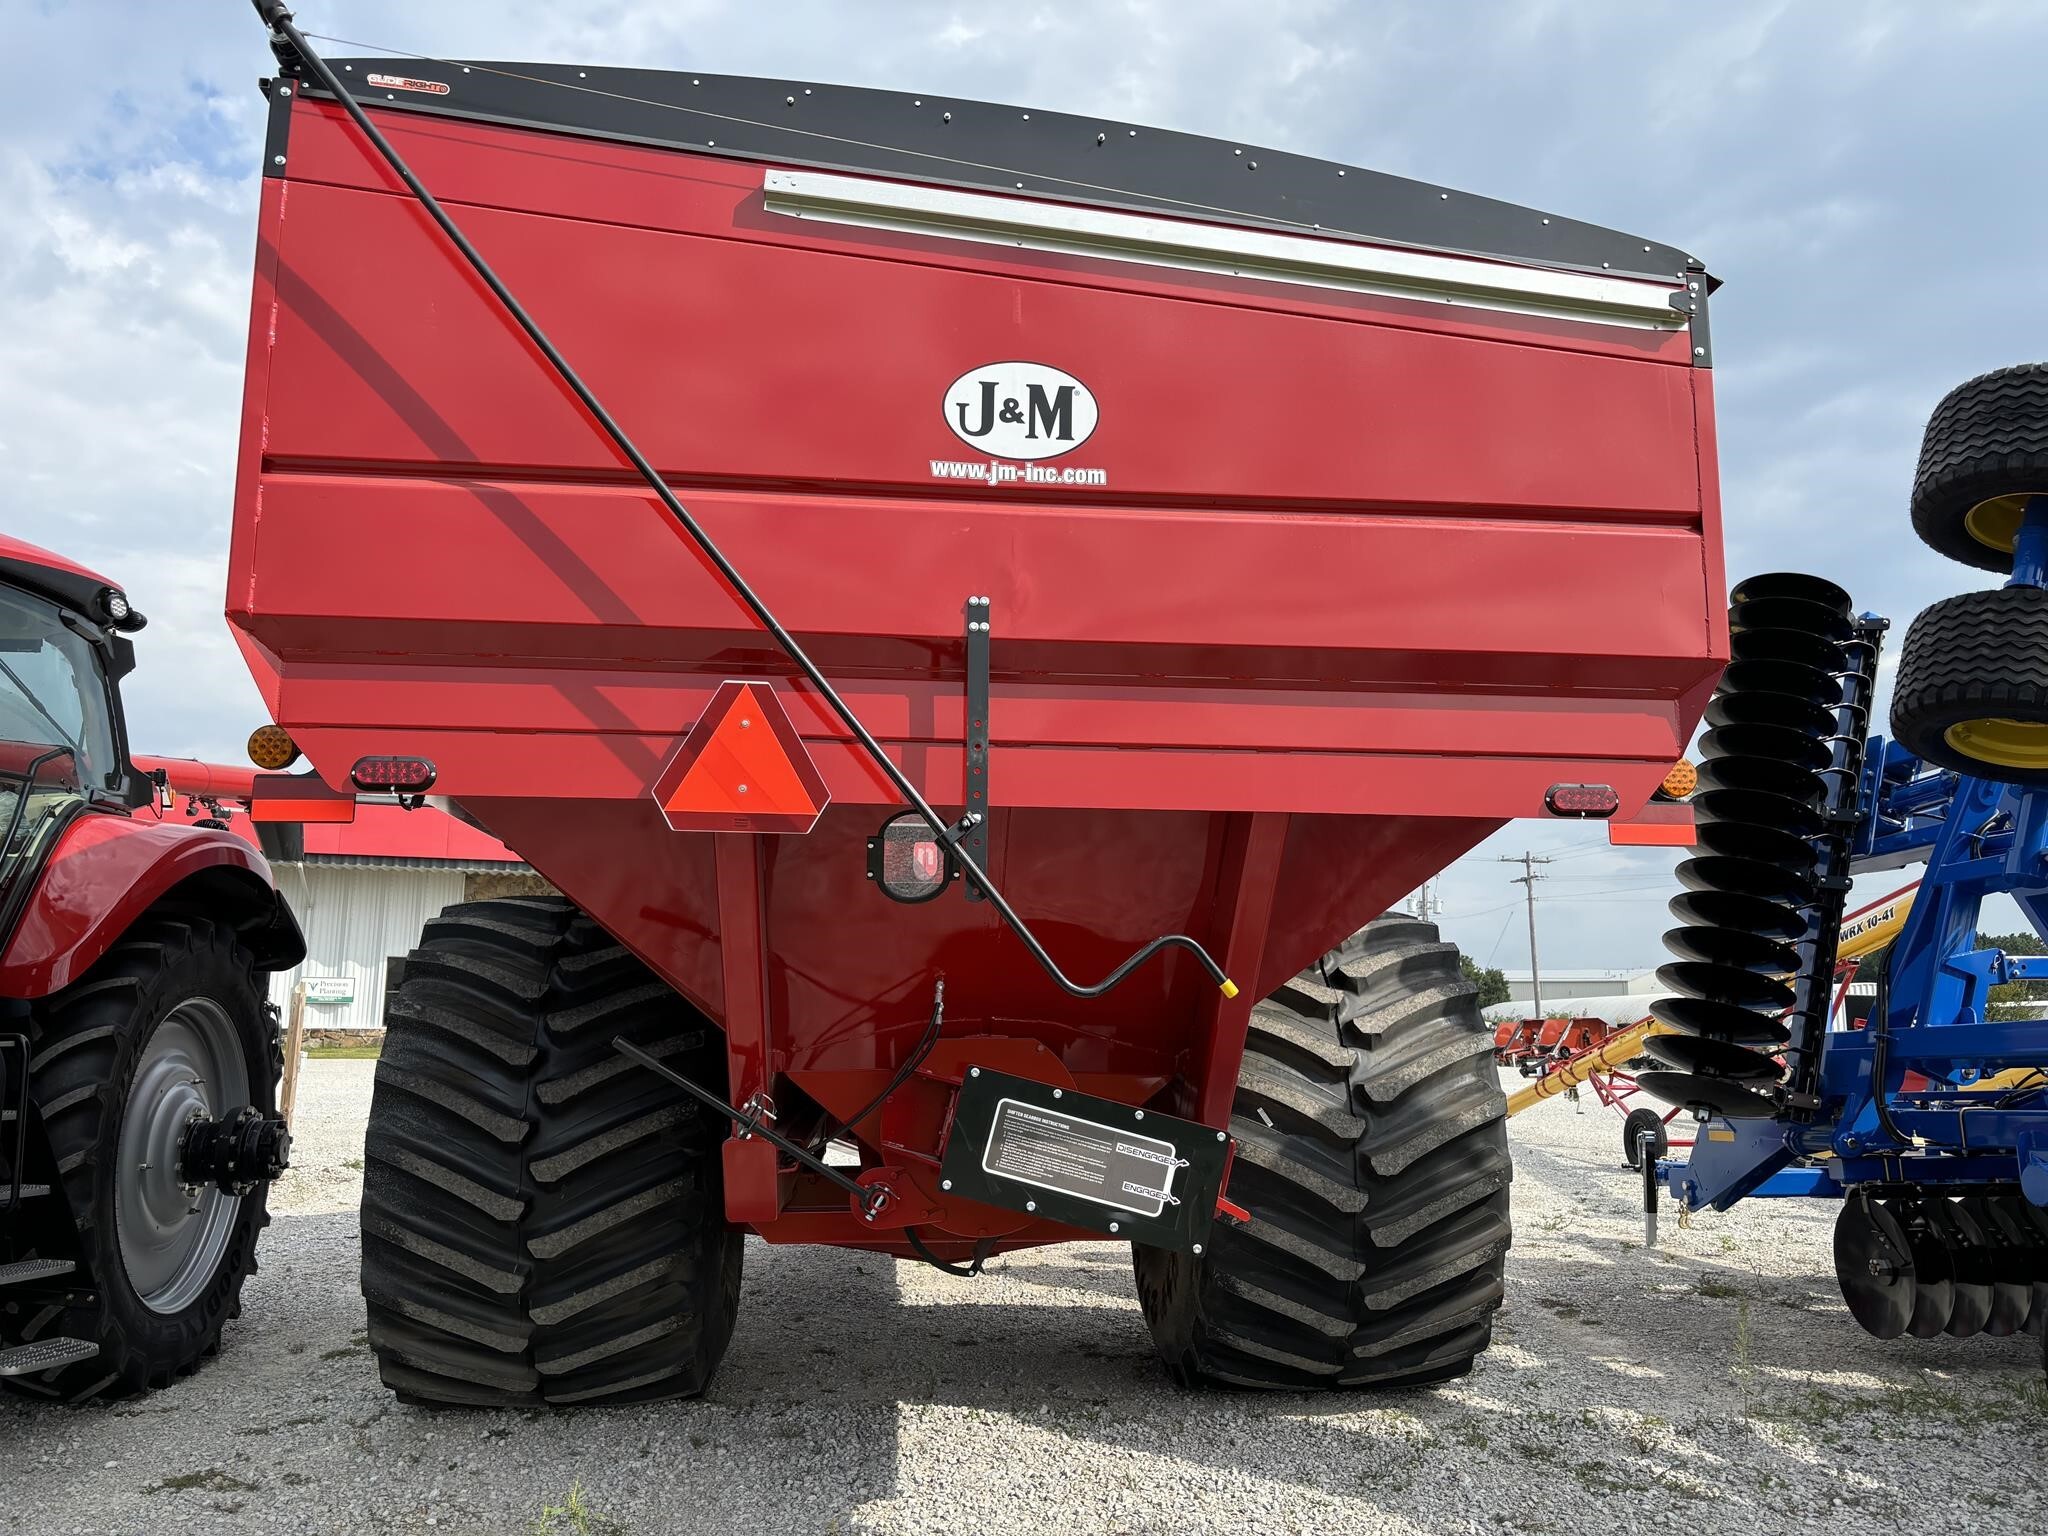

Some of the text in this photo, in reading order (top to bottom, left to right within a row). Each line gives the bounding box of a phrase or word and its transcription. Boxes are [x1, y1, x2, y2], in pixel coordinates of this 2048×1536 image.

[929, 460, 1107, 486] www.jm-inc.com
[1840, 907, 1895, 942] WRX 10-41
[319, 987, 346, 995] Planting
[1117, 1144, 1177, 1166] DISENGAGED
[1123, 1182, 1169, 1201] ENGAGED
